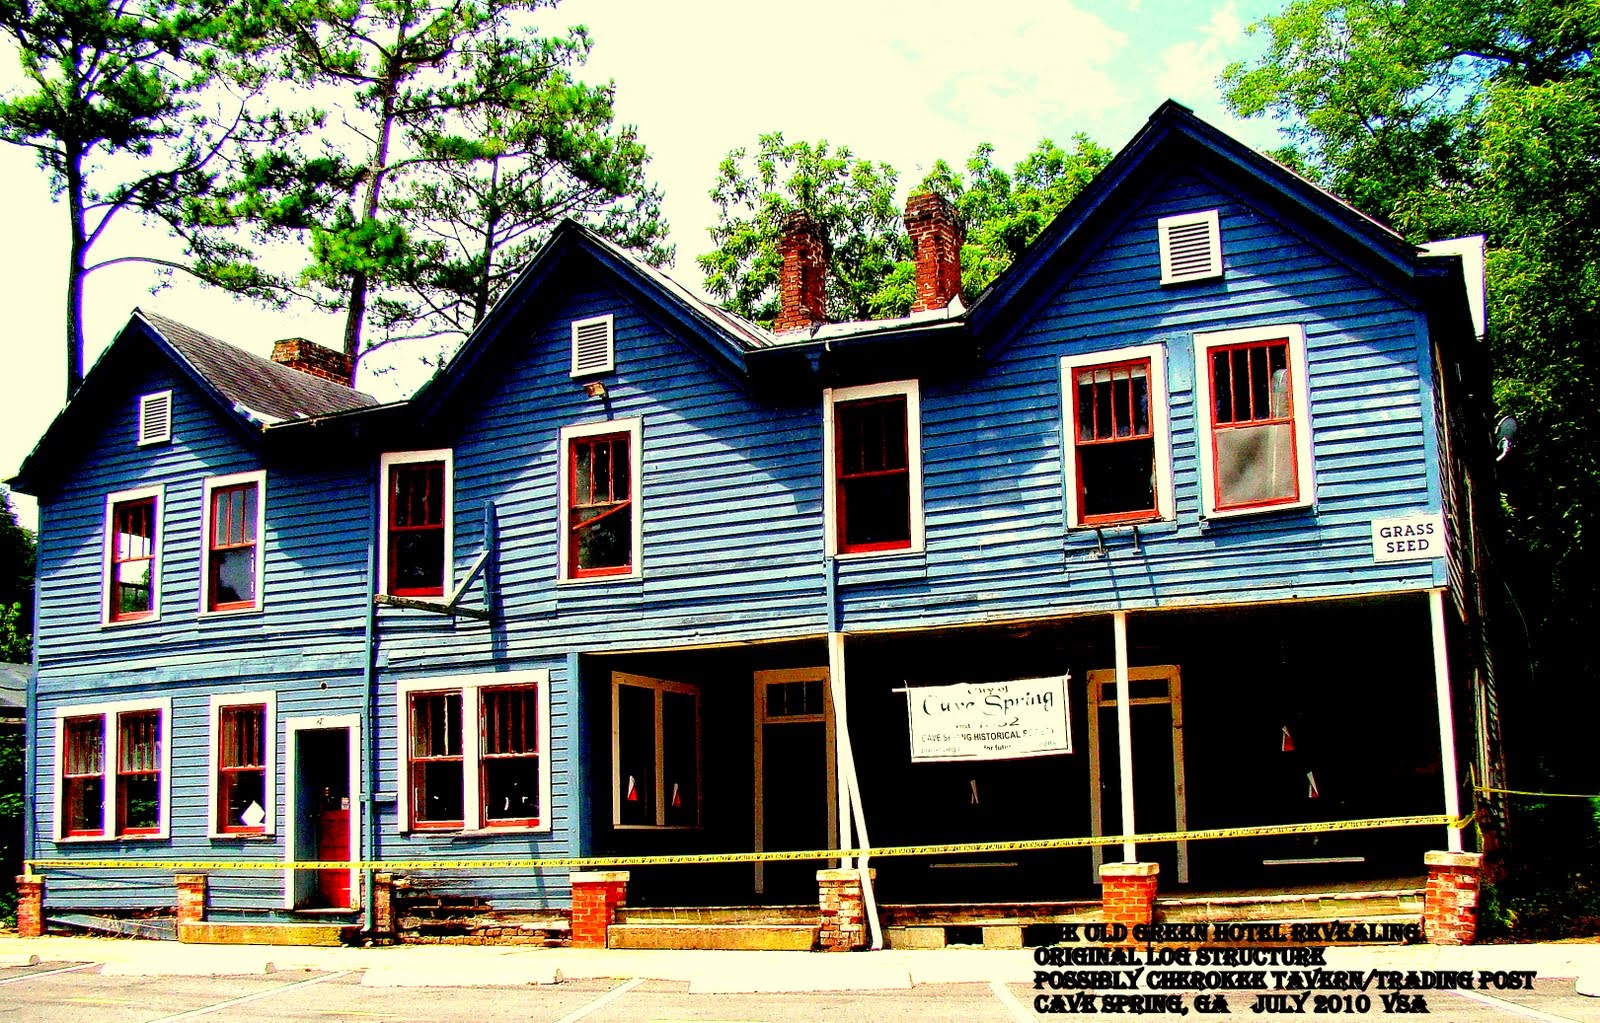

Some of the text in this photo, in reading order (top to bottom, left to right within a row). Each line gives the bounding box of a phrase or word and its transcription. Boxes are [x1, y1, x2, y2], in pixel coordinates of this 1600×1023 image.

[1380, 523, 1434, 538] GRASS
[1386, 539, 1429, 553] SEED
[922, 690, 1054, 717] Cave Spring
[921, 733, 943, 743] CAVE
[973, 730, 1021, 742] HISTORICAL
